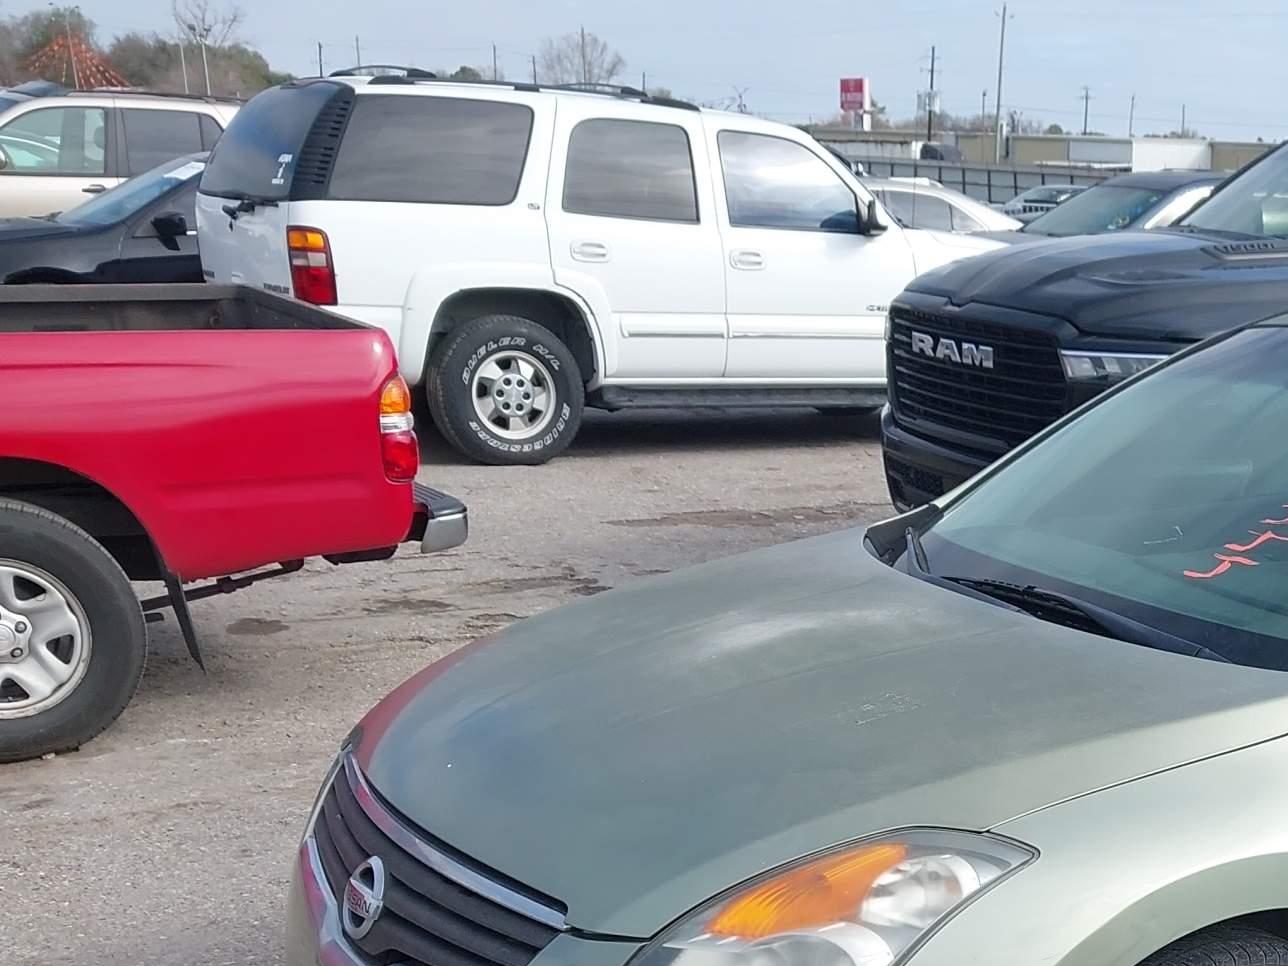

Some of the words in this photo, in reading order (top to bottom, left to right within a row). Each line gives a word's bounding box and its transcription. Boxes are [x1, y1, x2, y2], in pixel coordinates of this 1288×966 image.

[462, 336, 526, 385] DUELER
[911, 331, 993, 368] RAM
[468, 402, 571, 452] BRIDGESTONE
